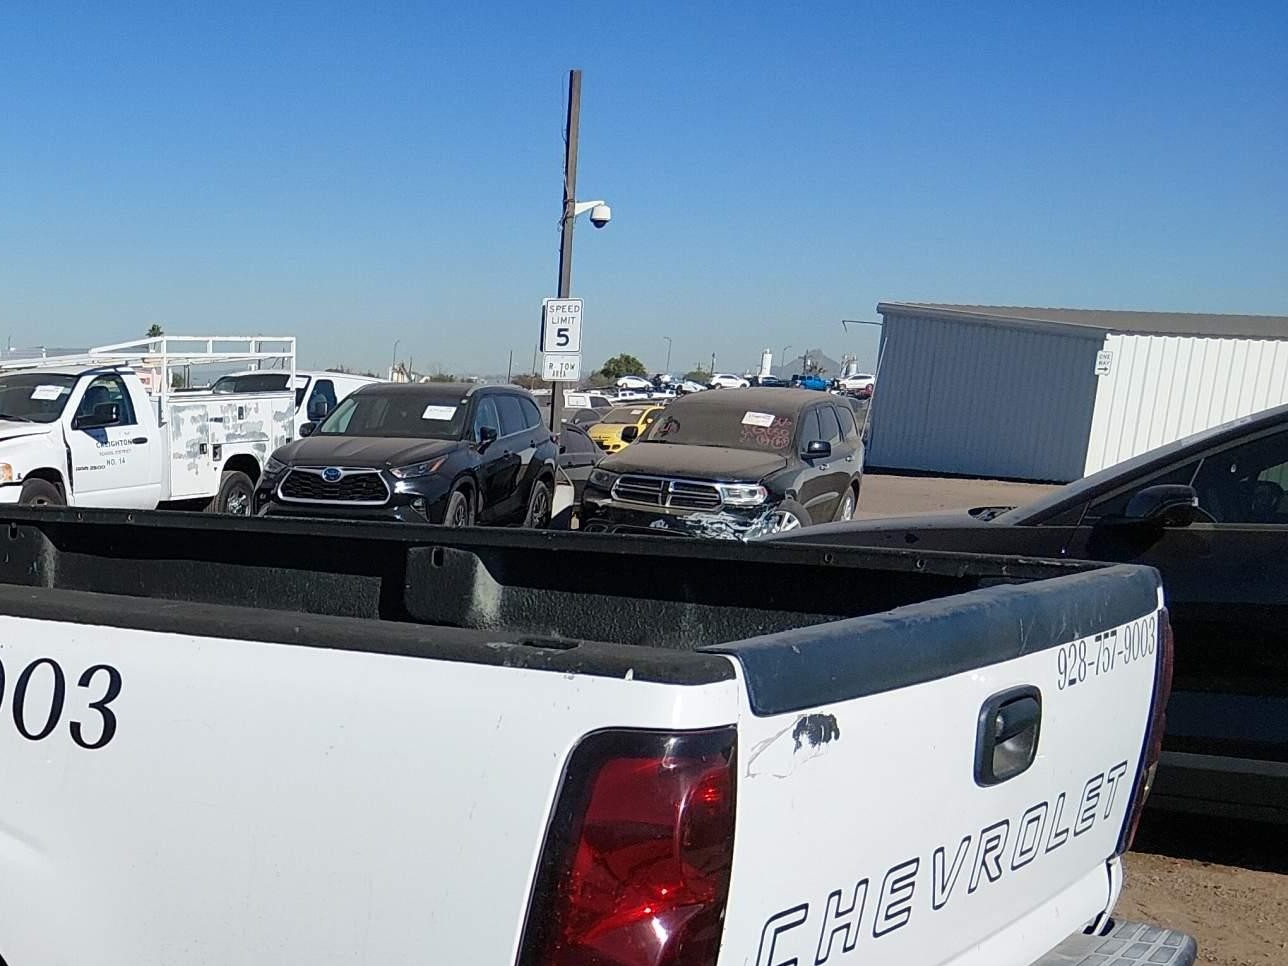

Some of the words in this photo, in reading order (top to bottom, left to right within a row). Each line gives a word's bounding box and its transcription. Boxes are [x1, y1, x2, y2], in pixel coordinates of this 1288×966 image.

[549, 305, 580, 313] SPEED
[552, 317, 576, 325] LIMIT
[556, 328, 569, 347] 5
[1057, 616, 1156, 691] 928-757-9003
